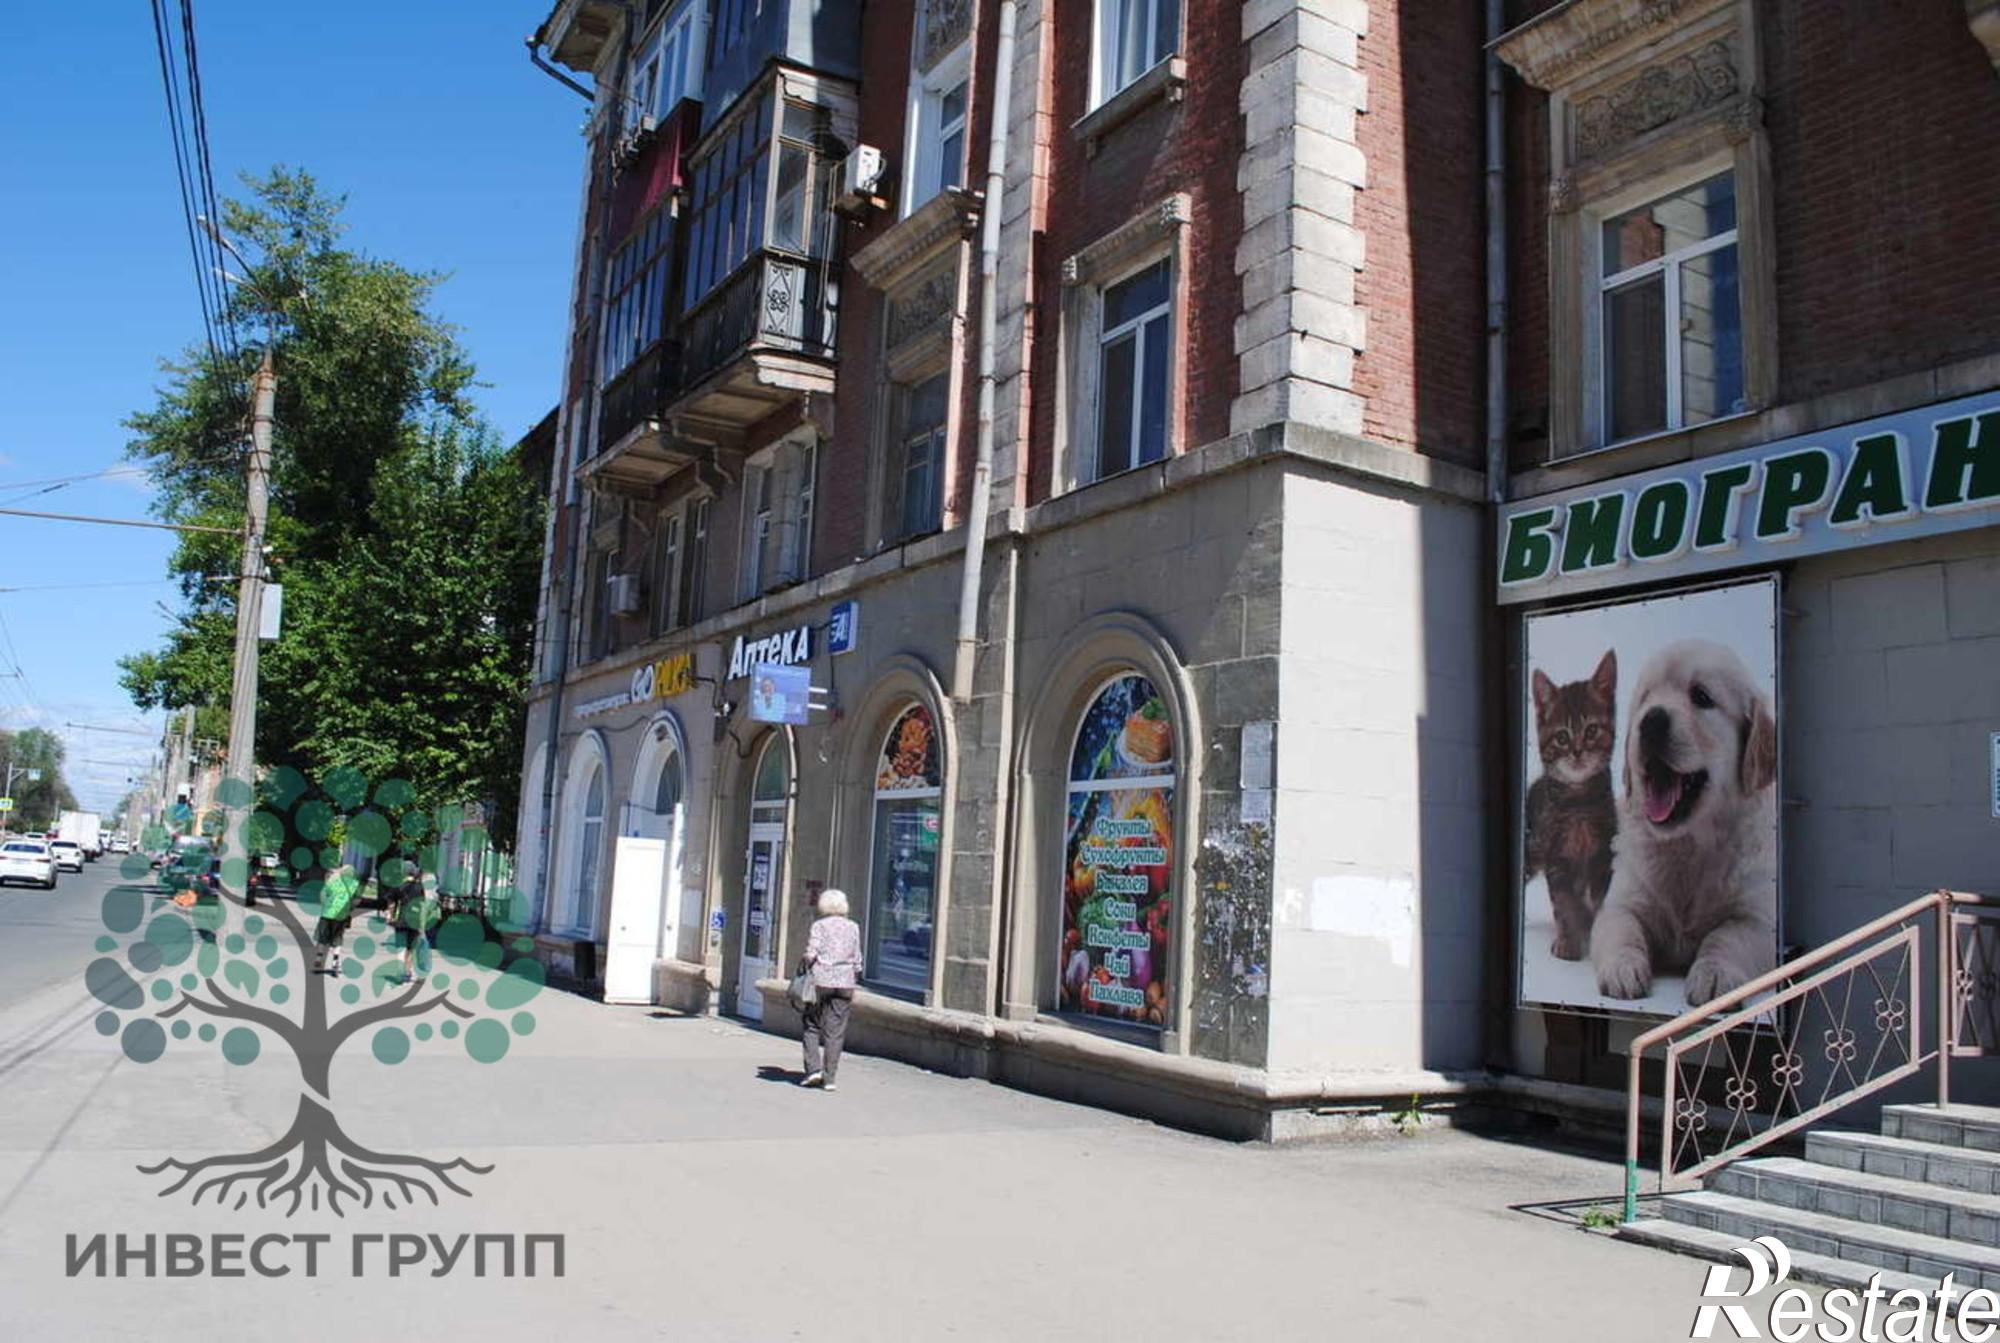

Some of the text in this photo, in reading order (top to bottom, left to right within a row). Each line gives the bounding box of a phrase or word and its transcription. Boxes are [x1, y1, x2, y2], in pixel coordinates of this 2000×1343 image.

[1096, 816, 1152, 838] Фрукты
[1082, 844, 1166, 866] Сухофрукты
[1104, 896, 1137, 919] Соки
[1088, 924, 1150, 949] Конфеты
[1105, 951, 1129, 977] Чай
[1089, 981, 1144, 1006] Пахлава
